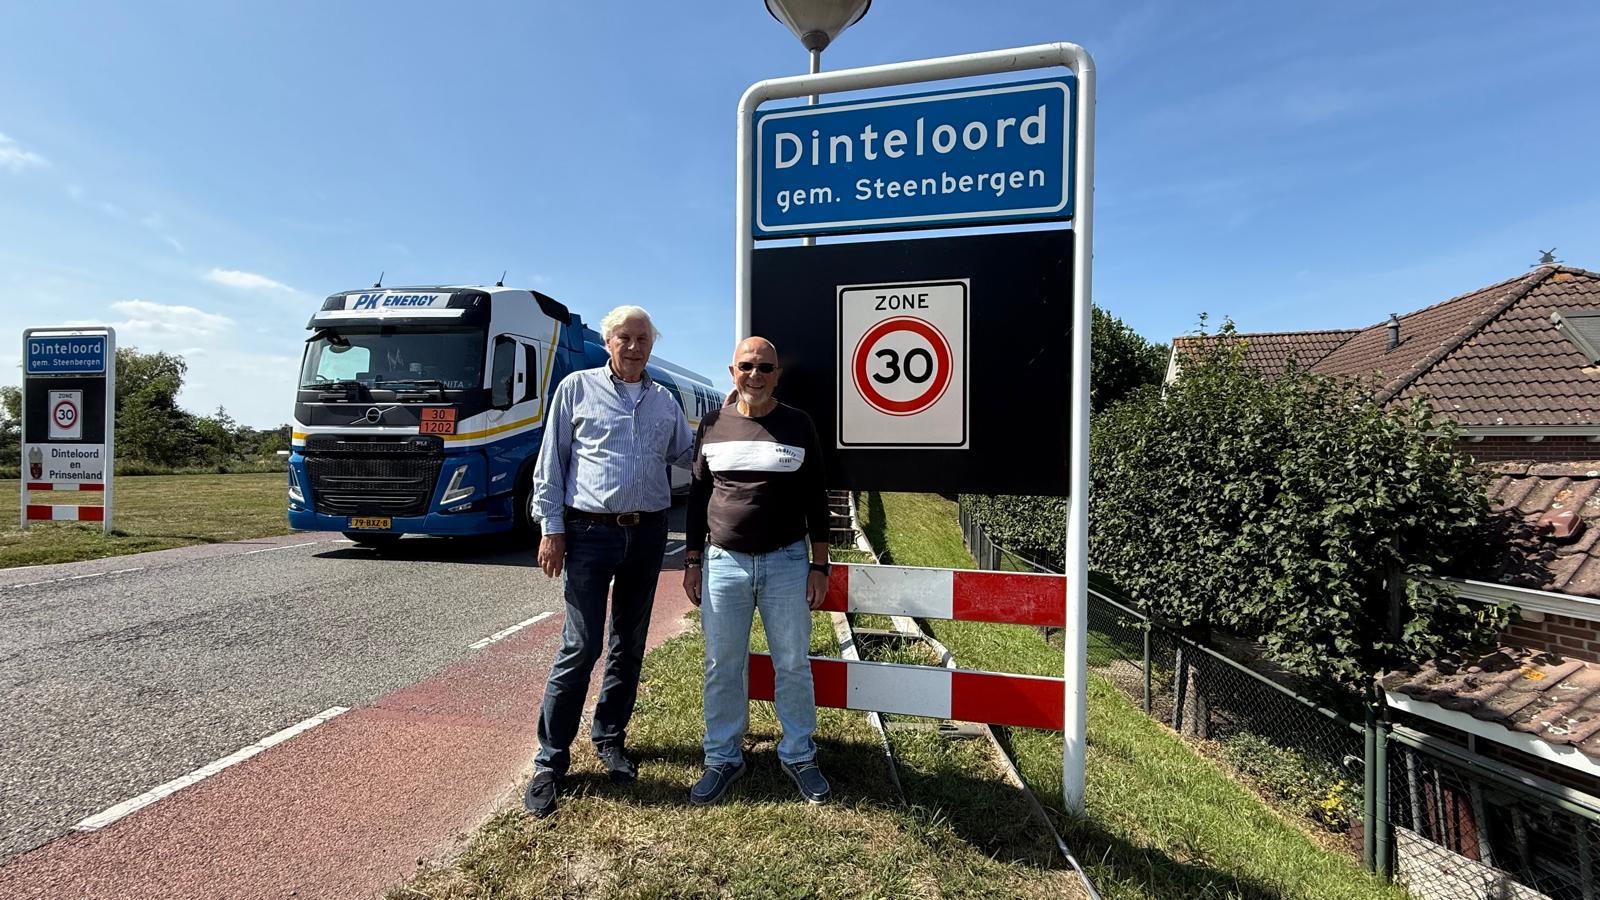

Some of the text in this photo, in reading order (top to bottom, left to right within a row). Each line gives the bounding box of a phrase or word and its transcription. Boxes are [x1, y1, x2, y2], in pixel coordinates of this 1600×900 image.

[775, 103, 1046, 169] Dinteloord
[776, 169, 1045, 213] gem. Steenbergen
[353, 293, 438, 309] PK ENERGY
[875, 293, 929, 310] ZONE
[31, 342, 101, 355] Dinteloord
[53, 358, 101, 367] Steenbergen
[872, 348, 933, 384] 30
[58, 409, 74, 420] 30
[432, 409, 445, 419] 30
[425, 422, 451, 432] 1202
[51, 448, 99, 458] Dinteloord
[49, 470, 103, 479] Prinsenland
